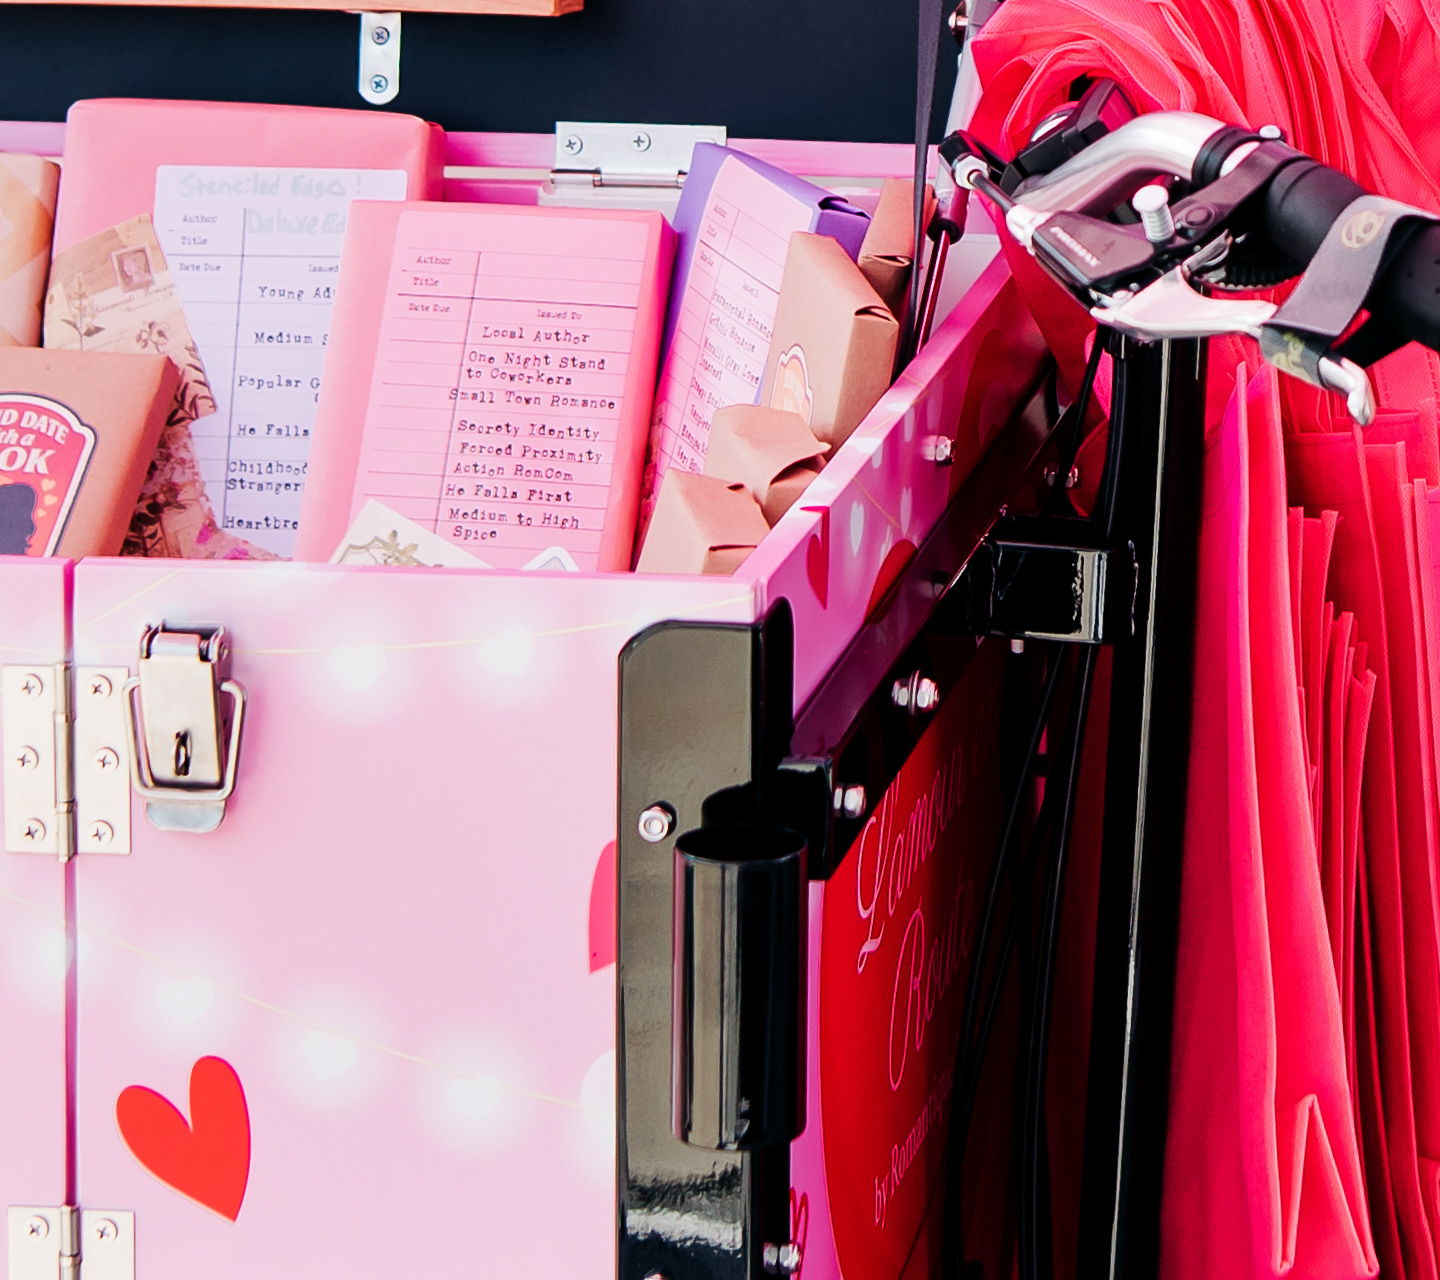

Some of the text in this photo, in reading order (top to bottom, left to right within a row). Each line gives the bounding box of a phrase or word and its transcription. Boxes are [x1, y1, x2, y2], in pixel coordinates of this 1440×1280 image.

[258, 285, 305, 301] Young
[254, 331, 314, 346] Medium
[483, 326, 590, 345] Local Author
[469, 351, 606, 371] One Night Stand
[237, 374, 302, 391] Popular
[466, 367, 573, 386] to Coworkers
[448, 388, 616, 410] Small Town Romance
[20, 410, 70, 446] DATE
[457, 420, 600, 441] Secrety Identity
[20, 433, 36, 446] a
[460, 442, 603, 464] Forced Proximity
[454, 462, 574, 482] Action RomCom
[445, 484, 573, 503] He Falls First
[448, 507, 580, 530] Medium to High
[452, 525, 497, 540] Spice
[874, 1172, 890, 1230] by
